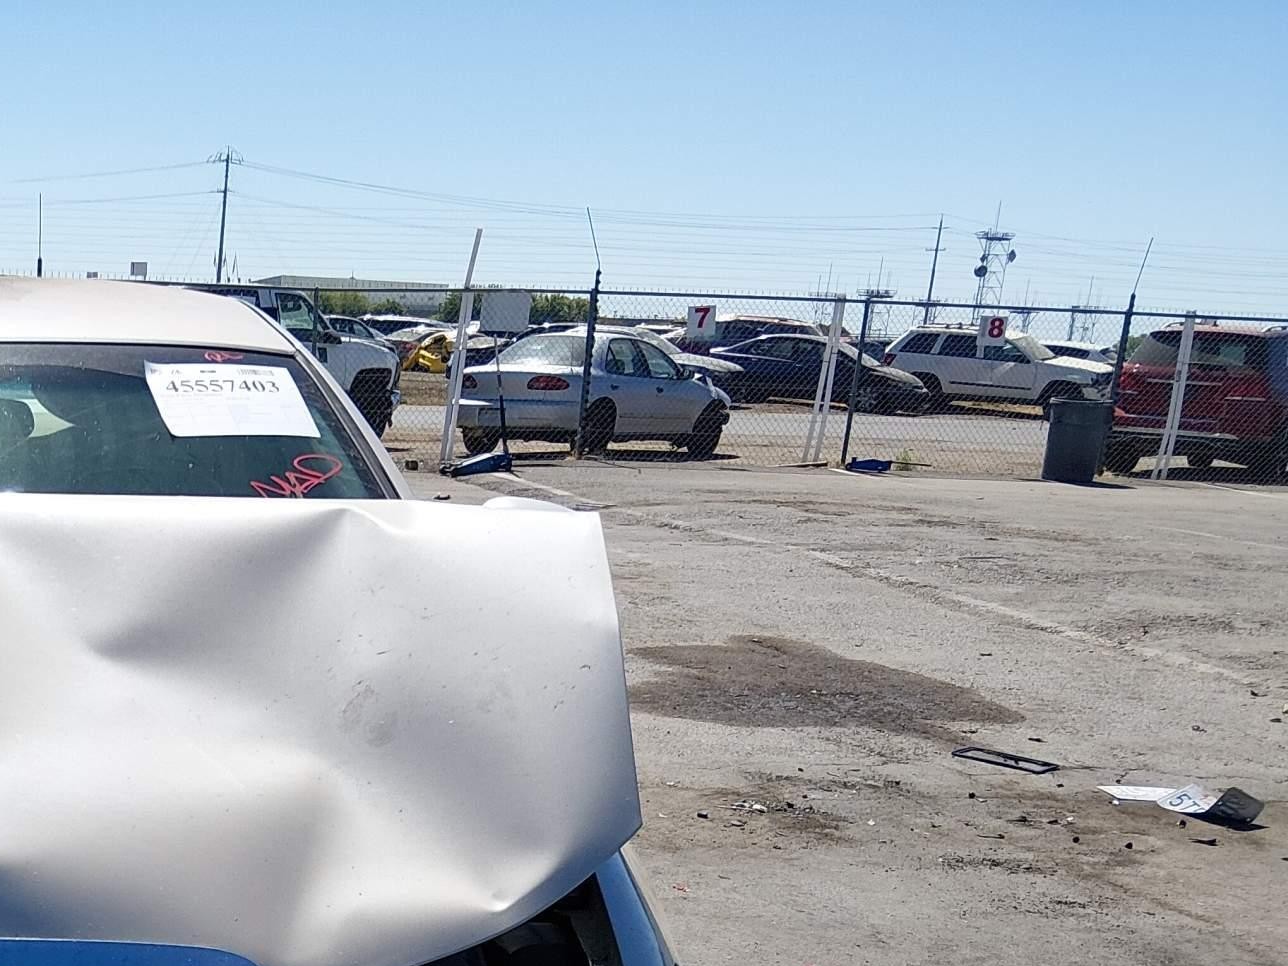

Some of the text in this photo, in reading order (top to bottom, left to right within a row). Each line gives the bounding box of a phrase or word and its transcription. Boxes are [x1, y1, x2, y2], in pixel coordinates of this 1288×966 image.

[694, 307, 711, 329] 7
[988, 317, 1004, 338] 8
[165, 379, 281, 393] 45557403
